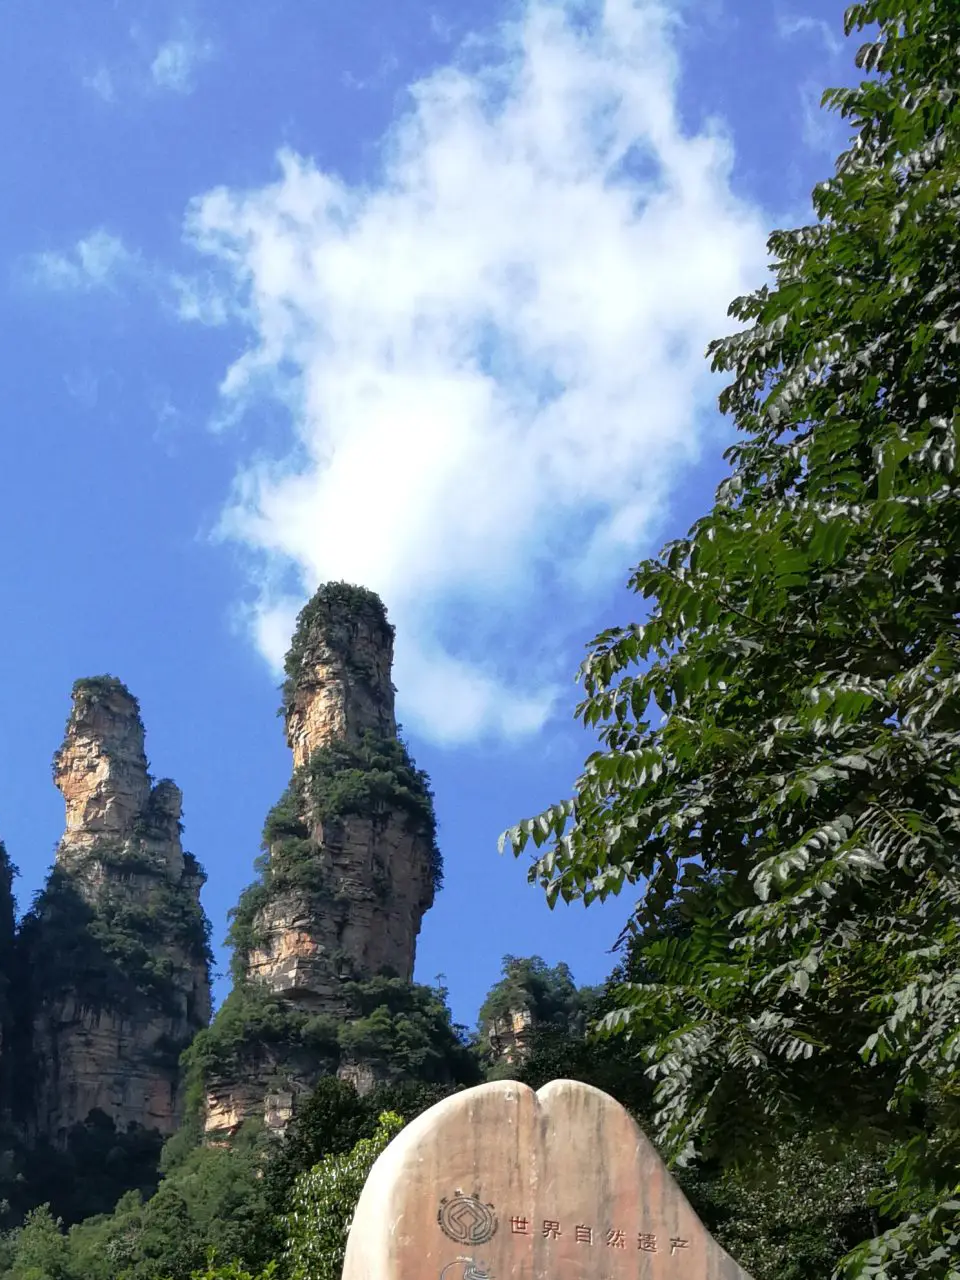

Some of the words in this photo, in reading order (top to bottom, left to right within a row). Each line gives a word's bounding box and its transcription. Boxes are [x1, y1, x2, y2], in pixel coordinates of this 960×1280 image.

[509, 1215, 689, 1256] 世界自然遗产
